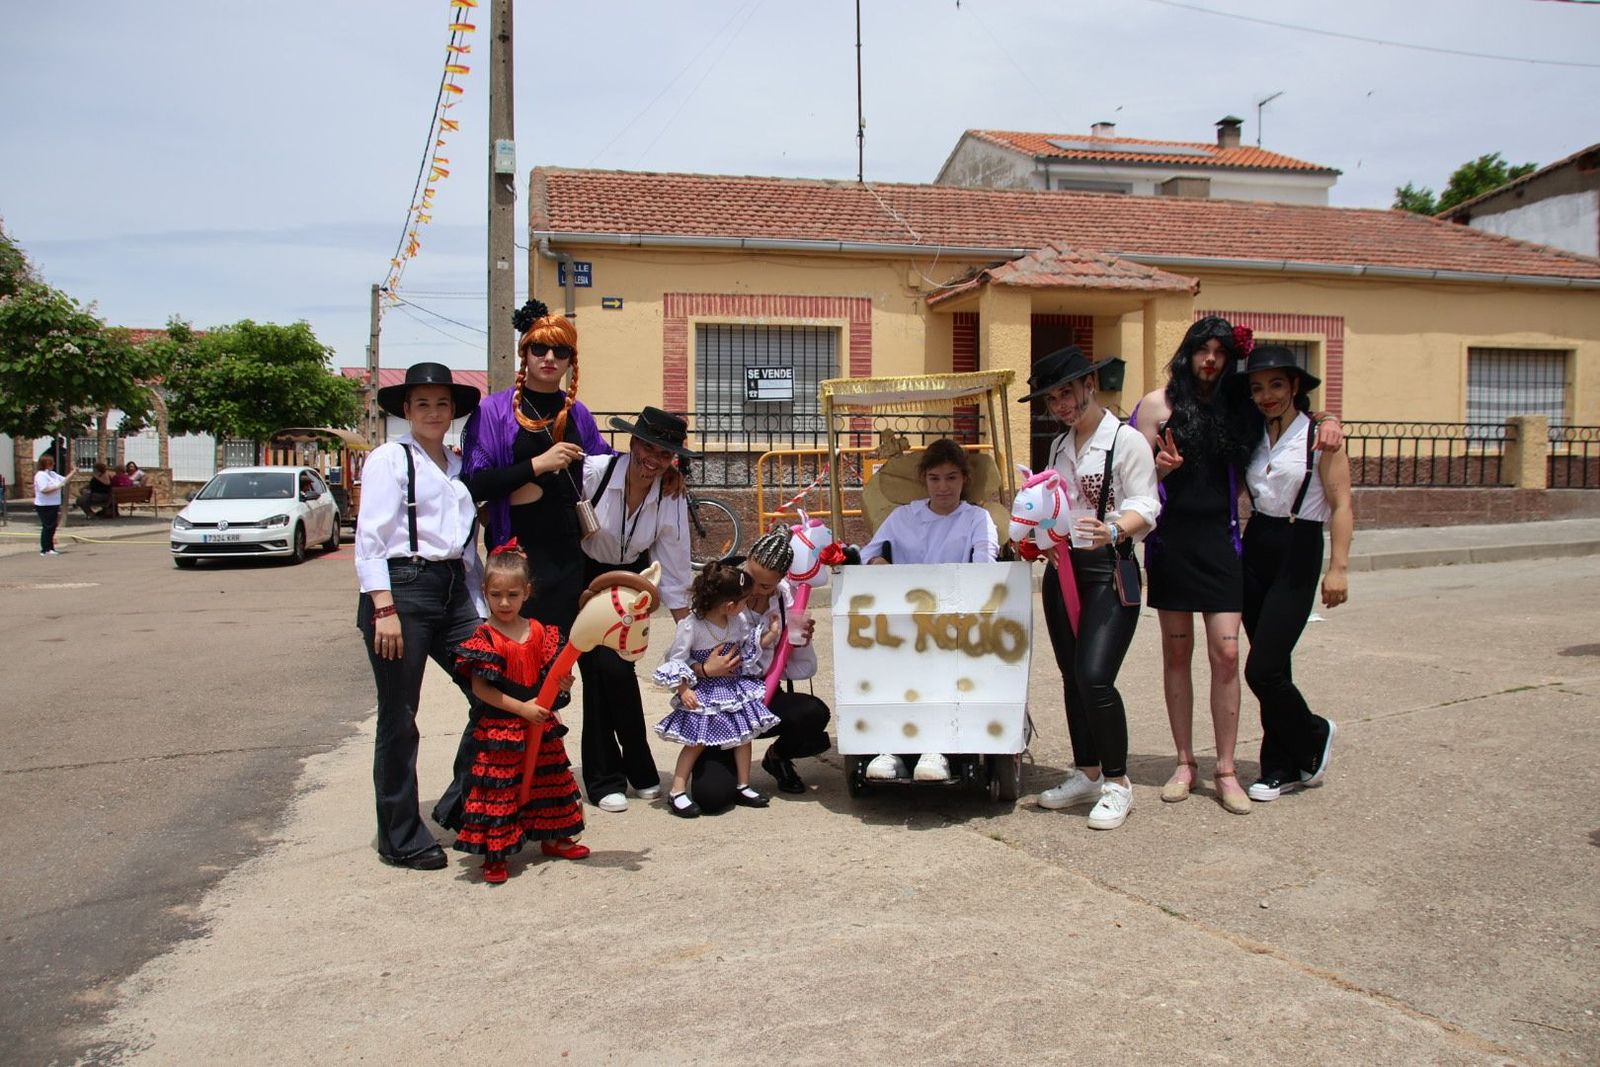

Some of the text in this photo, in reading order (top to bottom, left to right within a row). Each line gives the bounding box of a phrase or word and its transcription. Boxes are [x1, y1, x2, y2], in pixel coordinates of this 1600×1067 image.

[561, 264, 589, 273] CLLE
[747, 368, 793, 379] SE VENDE
